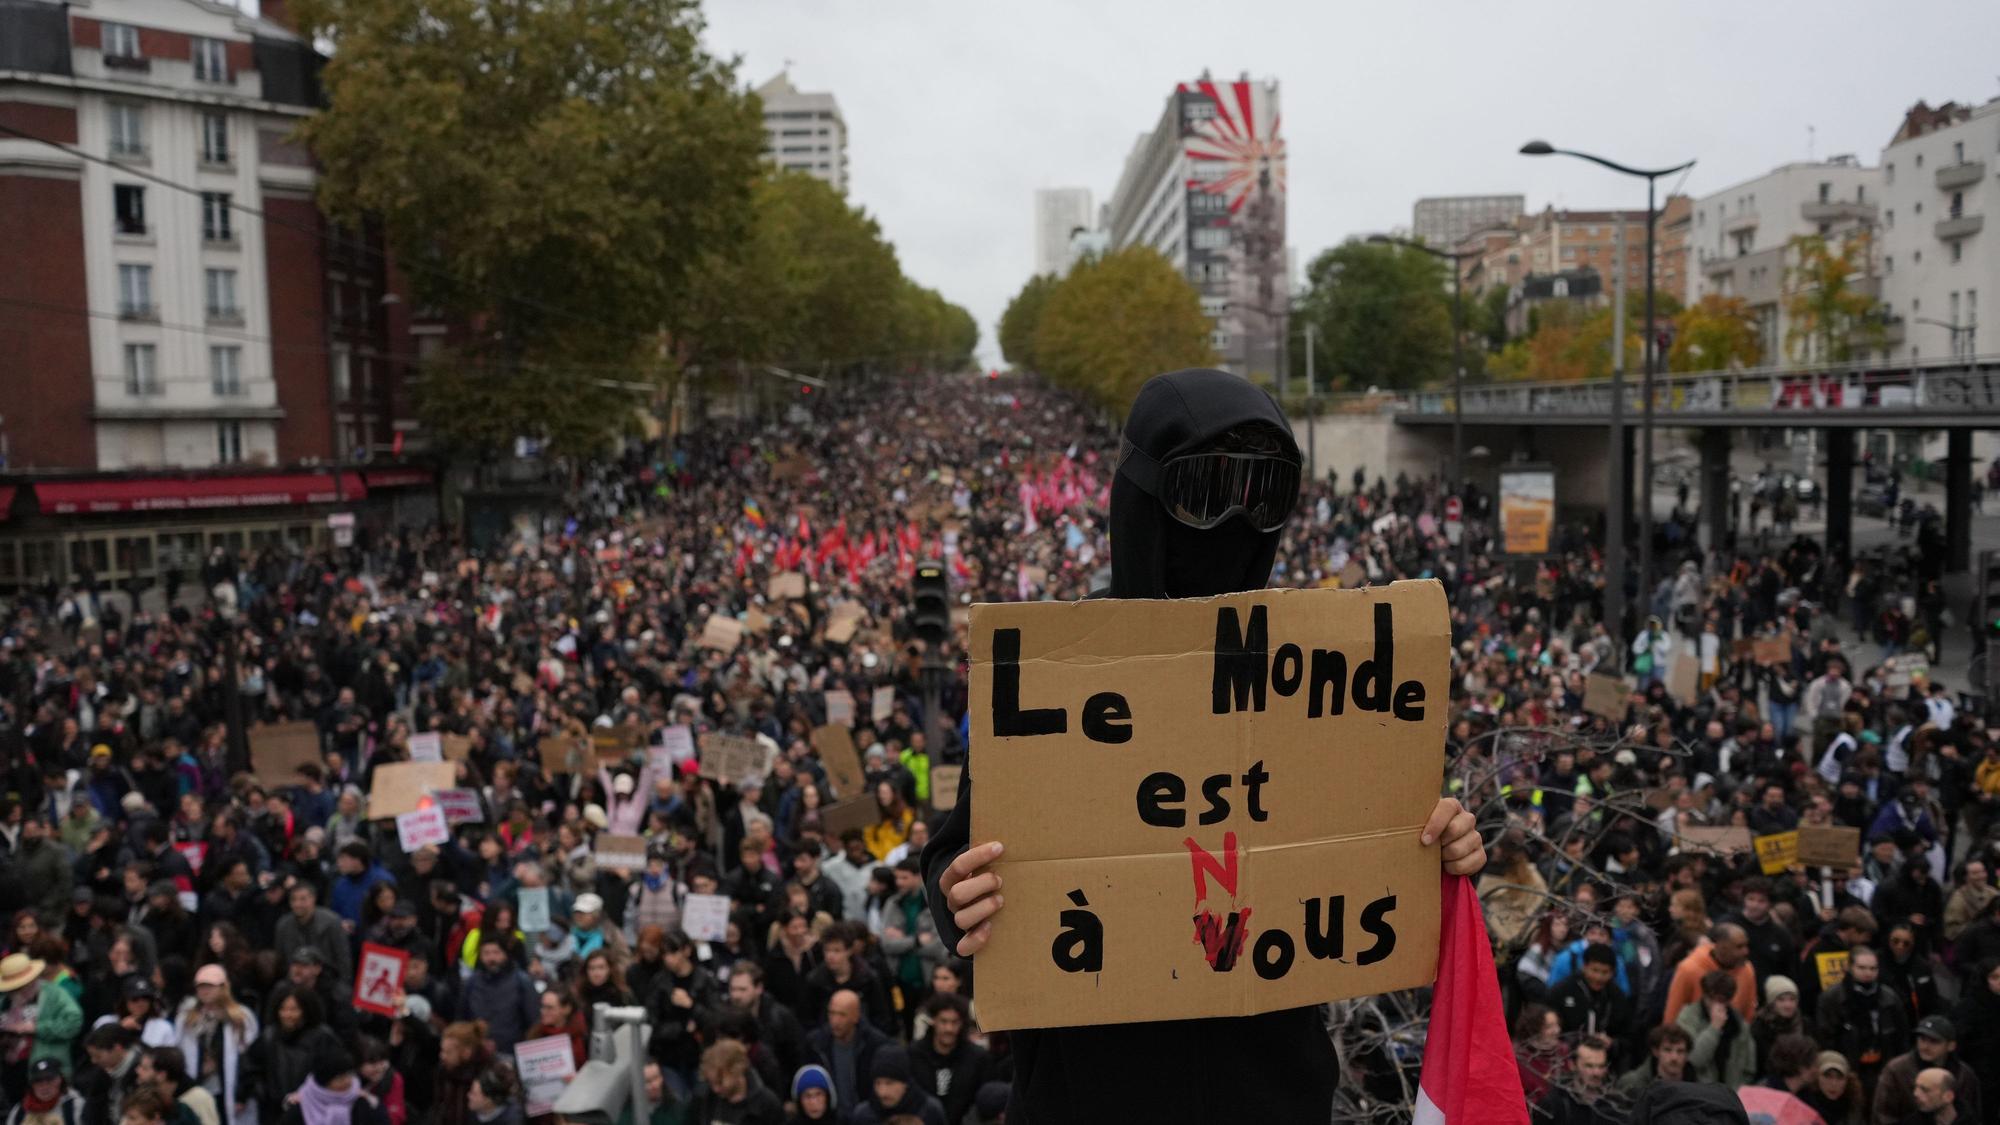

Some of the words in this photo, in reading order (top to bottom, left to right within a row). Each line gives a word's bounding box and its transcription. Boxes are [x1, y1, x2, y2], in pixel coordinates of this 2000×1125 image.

[992, 628, 1133, 744] Le
[1212, 603, 1426, 722] Monde
[1137, 760, 1269, 828] est
[1051, 889, 1104, 973] à
